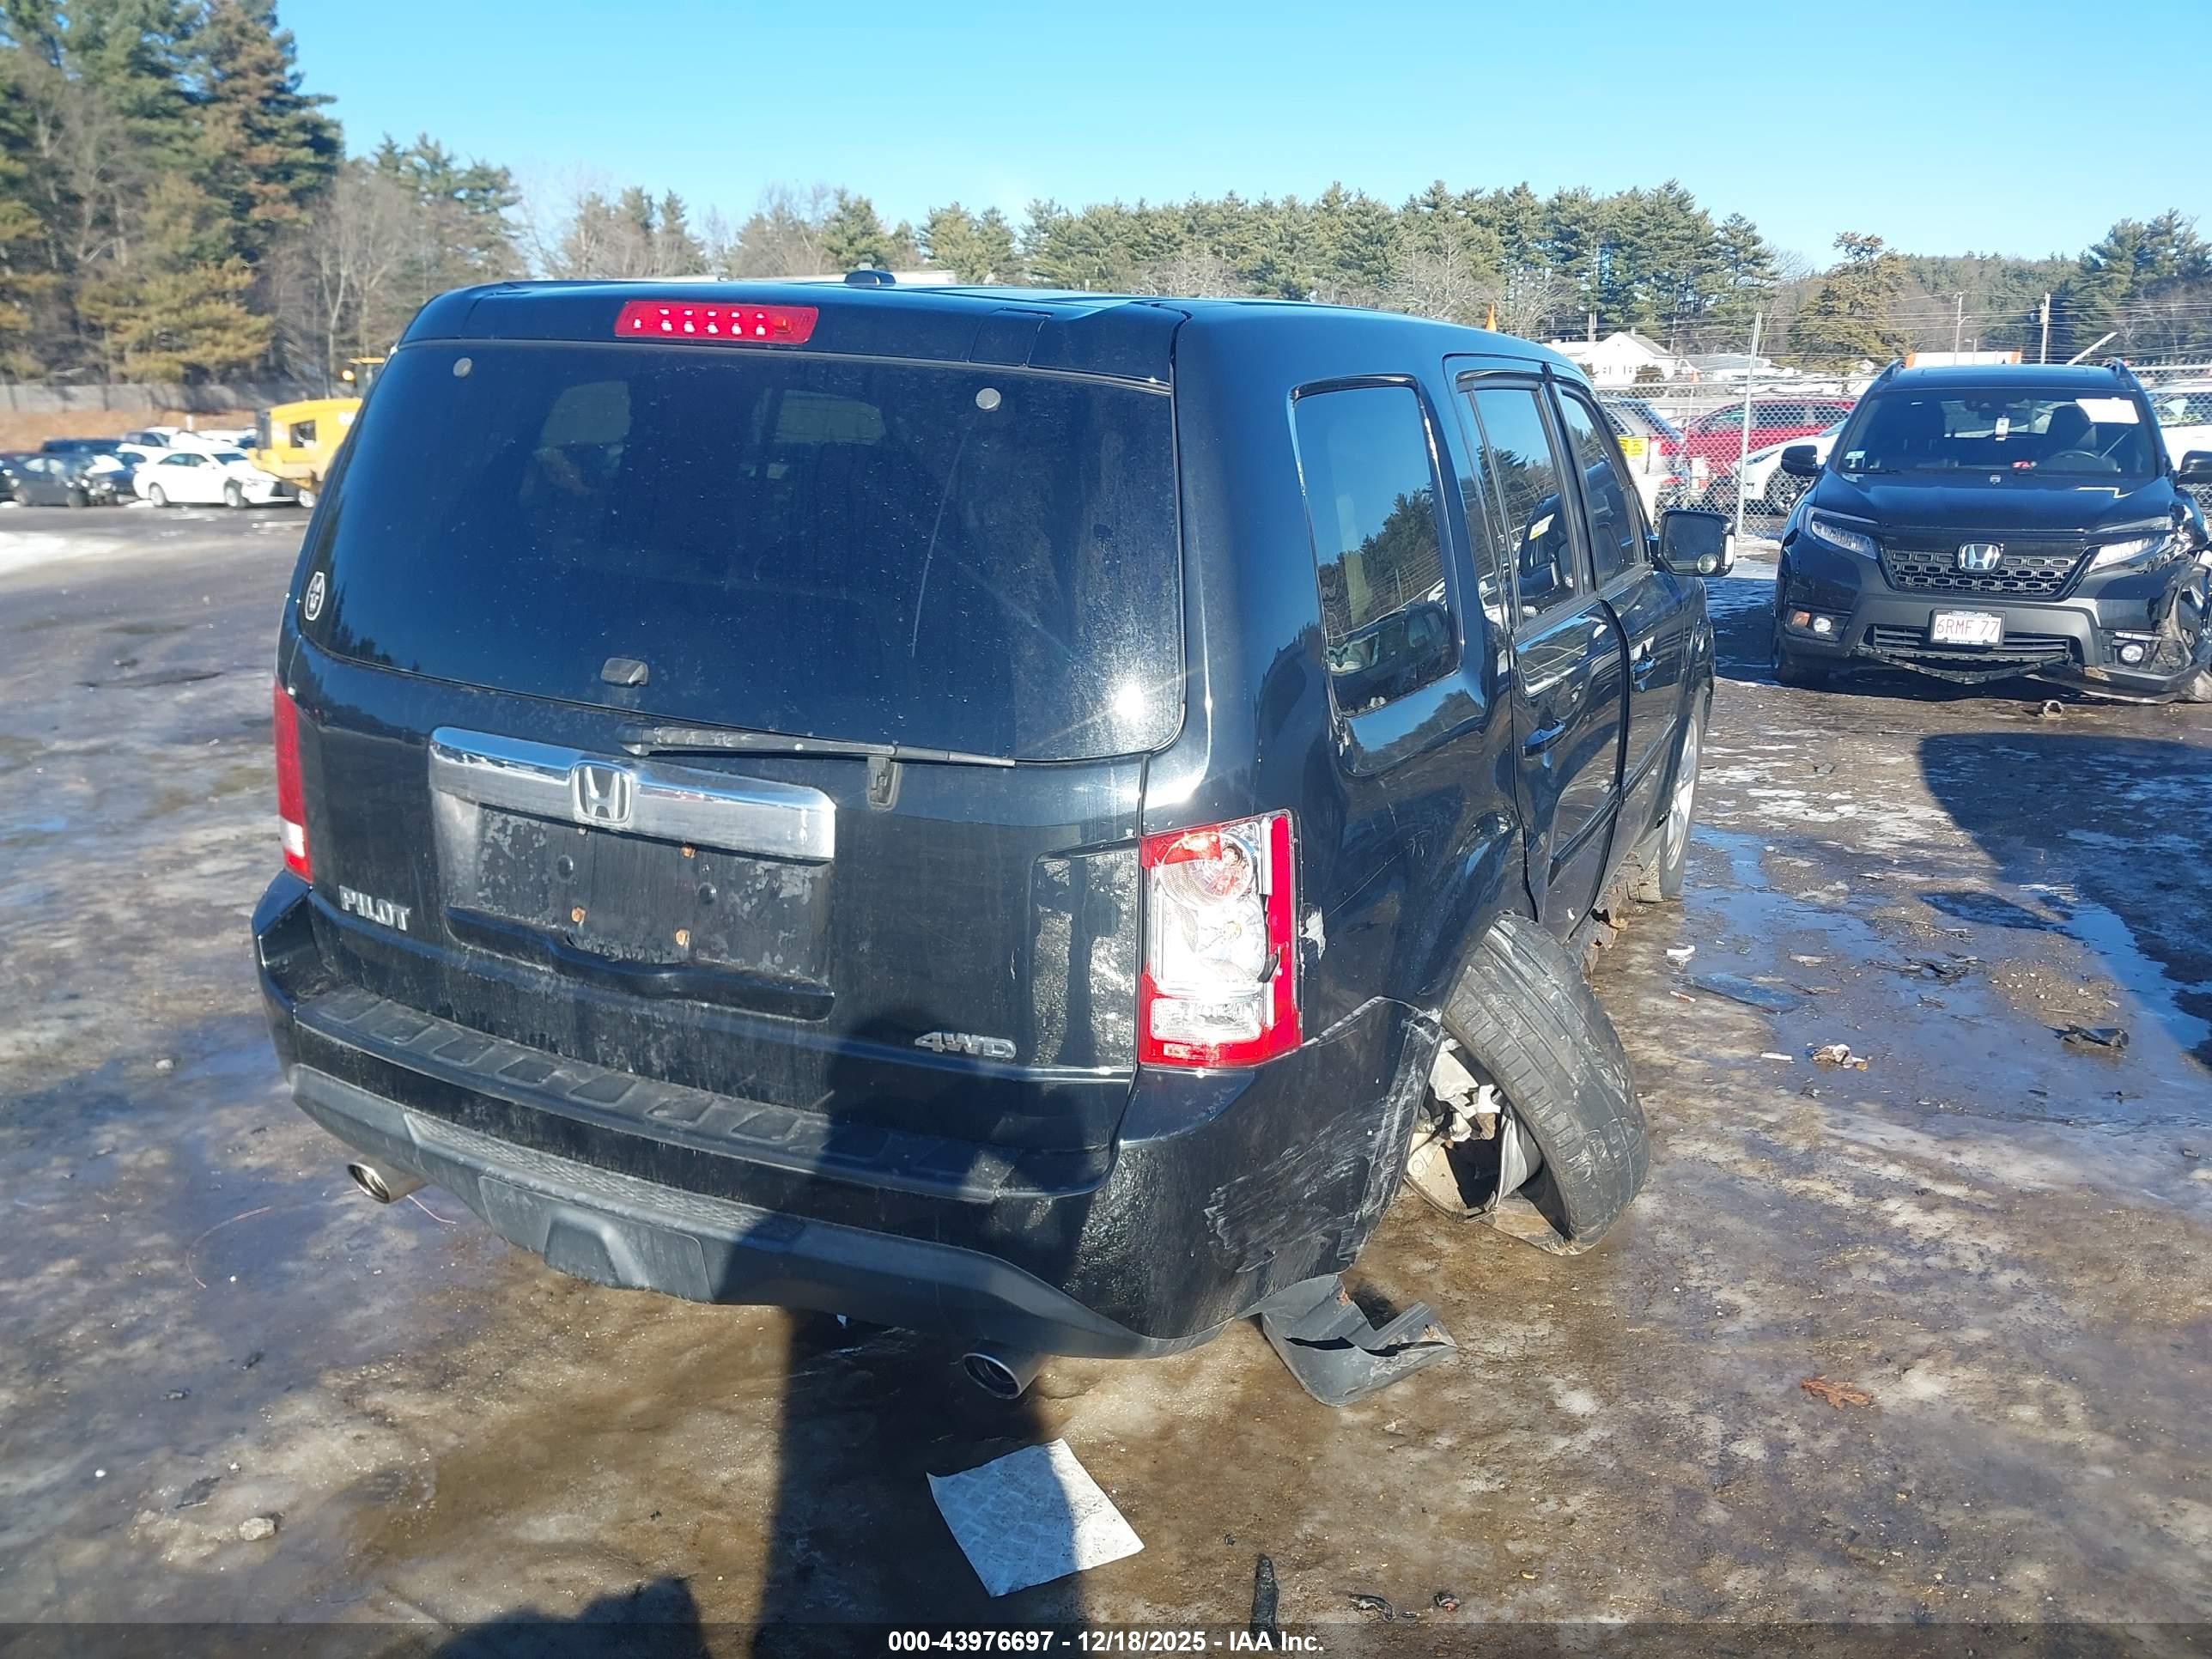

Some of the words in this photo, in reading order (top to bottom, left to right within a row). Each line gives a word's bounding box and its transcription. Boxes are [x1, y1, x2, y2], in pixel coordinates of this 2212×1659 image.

[1936, 618, 1974, 636] 6RMF
[1980, 620, 2000, 636] 77
[338, 884, 412, 932] PILOT
[915, 1031, 1017, 1060] 4WD
